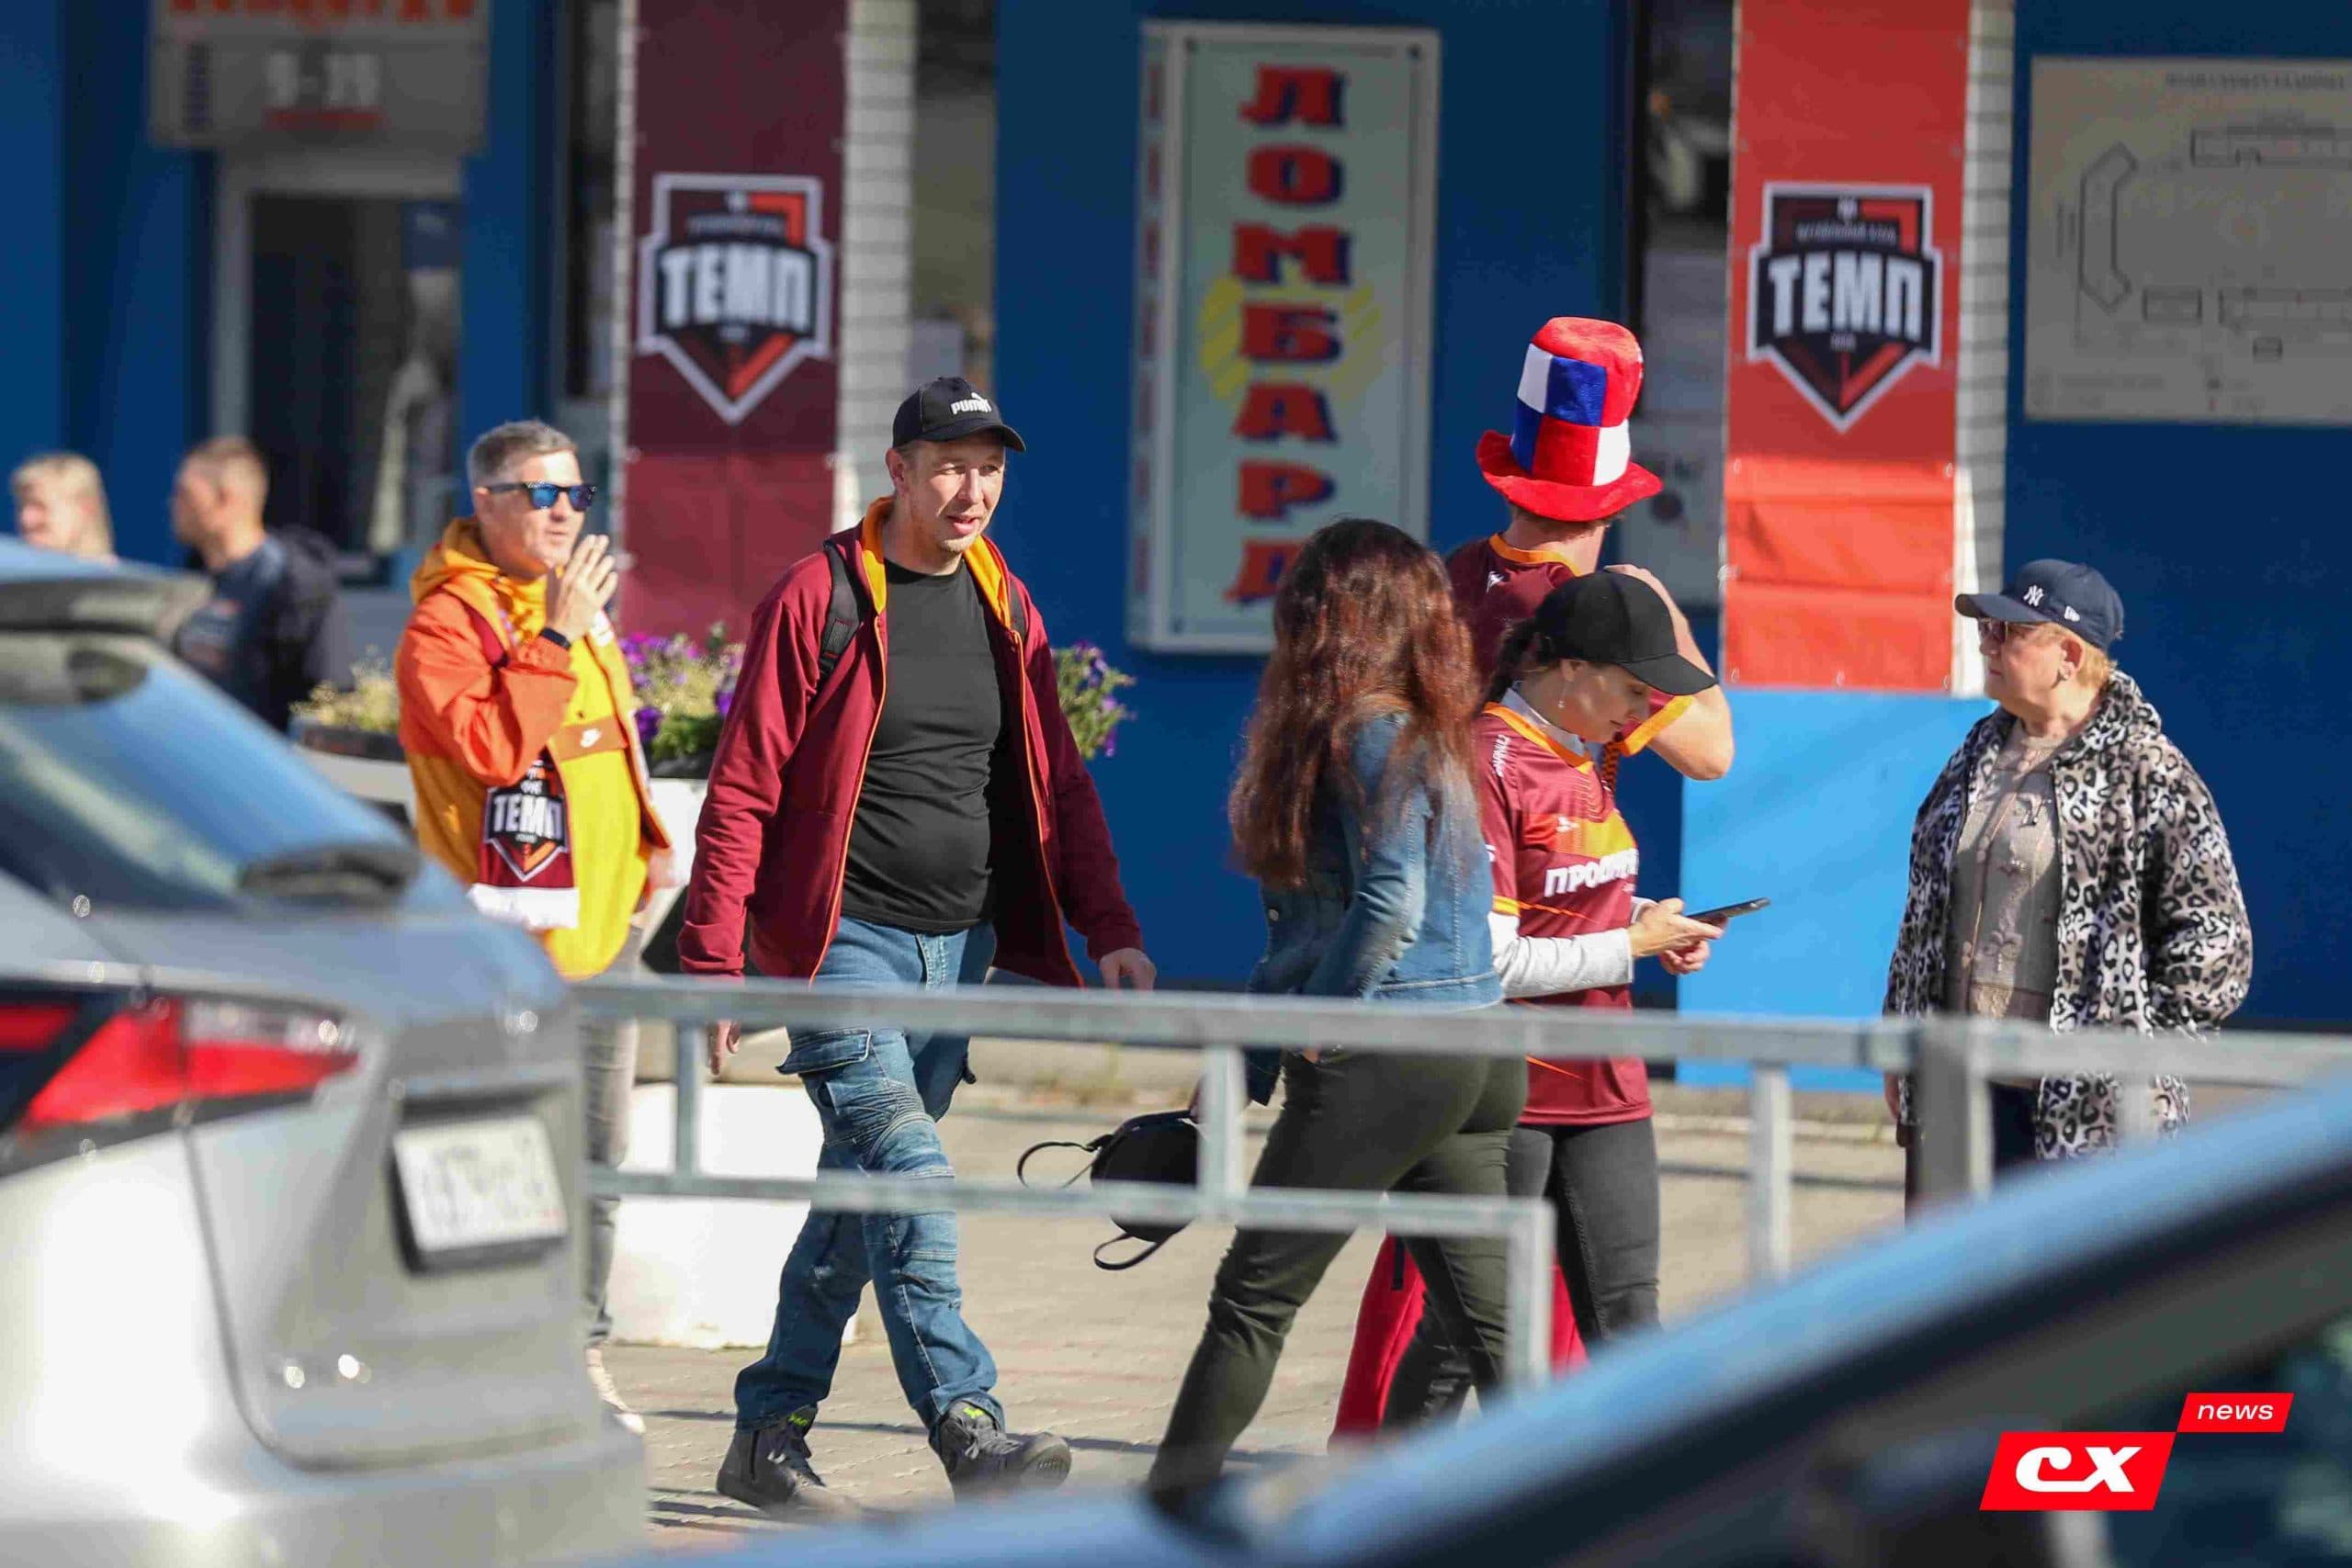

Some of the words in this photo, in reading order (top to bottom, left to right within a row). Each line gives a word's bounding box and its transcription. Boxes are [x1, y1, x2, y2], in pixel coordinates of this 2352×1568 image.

[660, 243, 811, 330] ТЕМП
[1768, 251, 1923, 342] ТЕМП
[2023, 584, 2044, 607] NY
[493, 794, 563, 841] ТЕМП
